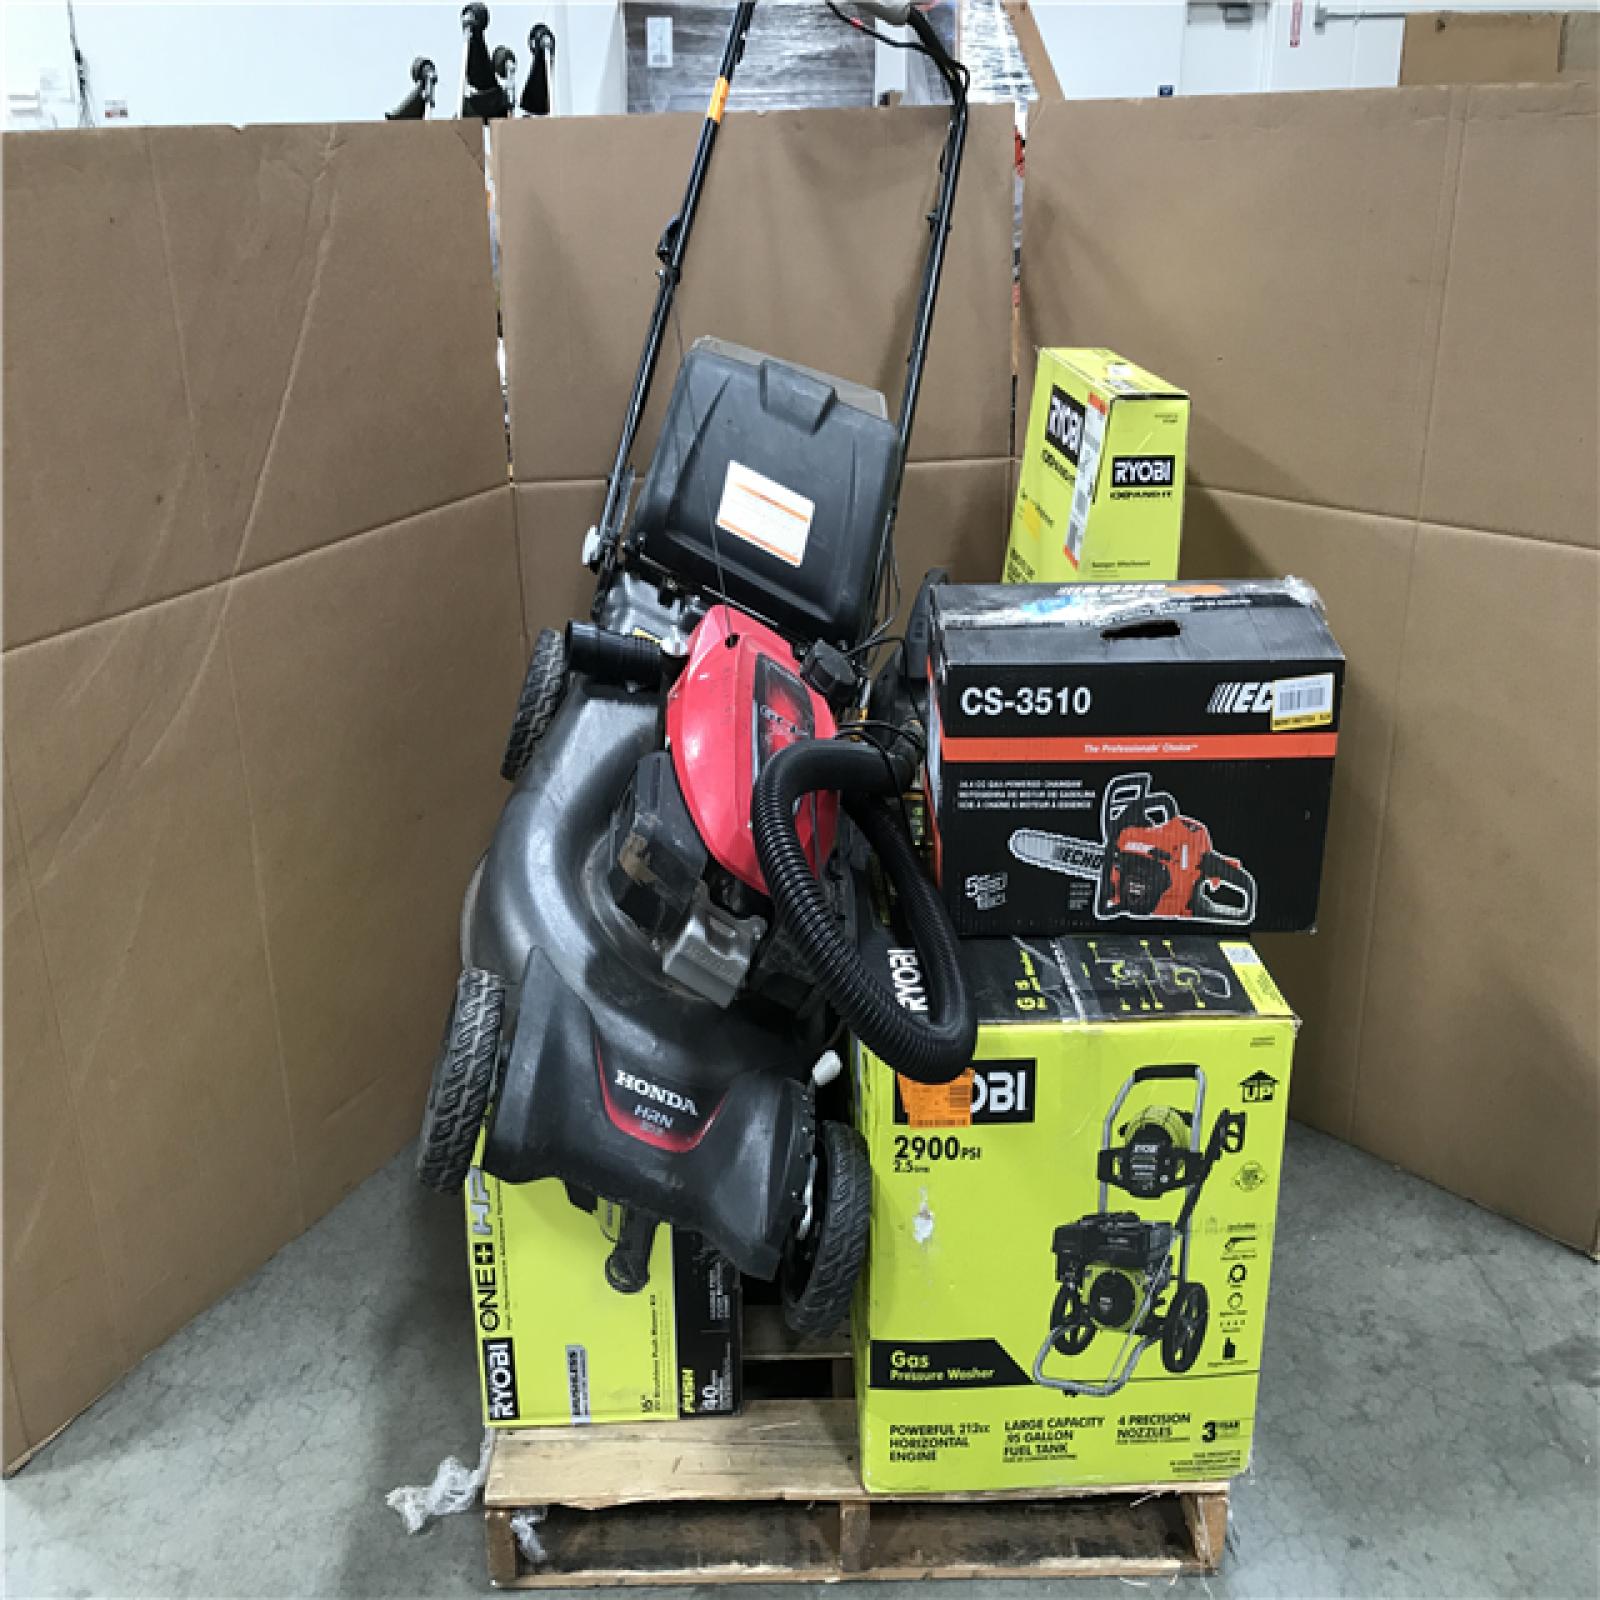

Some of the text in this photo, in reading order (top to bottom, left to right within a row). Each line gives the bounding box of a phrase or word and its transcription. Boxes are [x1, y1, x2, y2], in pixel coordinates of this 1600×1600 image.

[1115, 459, 1171, 484] RYOBI
[960, 686, 1091, 715] CS-3510
[888, 949, 928, 1011] RYOBI
[615, 1069, 698, 1116] HONDA
[894, 1136, 960, 1161] 2900
[890, 1350, 929, 1368] Gas
[487, 1344, 516, 1418] RYOBI
[890, 1367, 995, 1381] Pressure Washer
[682, 1368, 695, 1414] PUSH
[1004, 1417, 1105, 1431] LARGE CAPACITY
[1117, 1413, 1191, 1427] 4 PRECISION
[889, 1424, 955, 1435] POWERFUL
[1024, 1430, 1073, 1442] GALLON
[1117, 1427, 1173, 1439] NOZZLES
[1202, 1421, 1217, 1442] 3
[889, 1436, 970, 1449] HORIZONTAL
[1004, 1443, 1068, 1456] FUEL TANK
[889, 1450, 937, 1462] ENGINE
